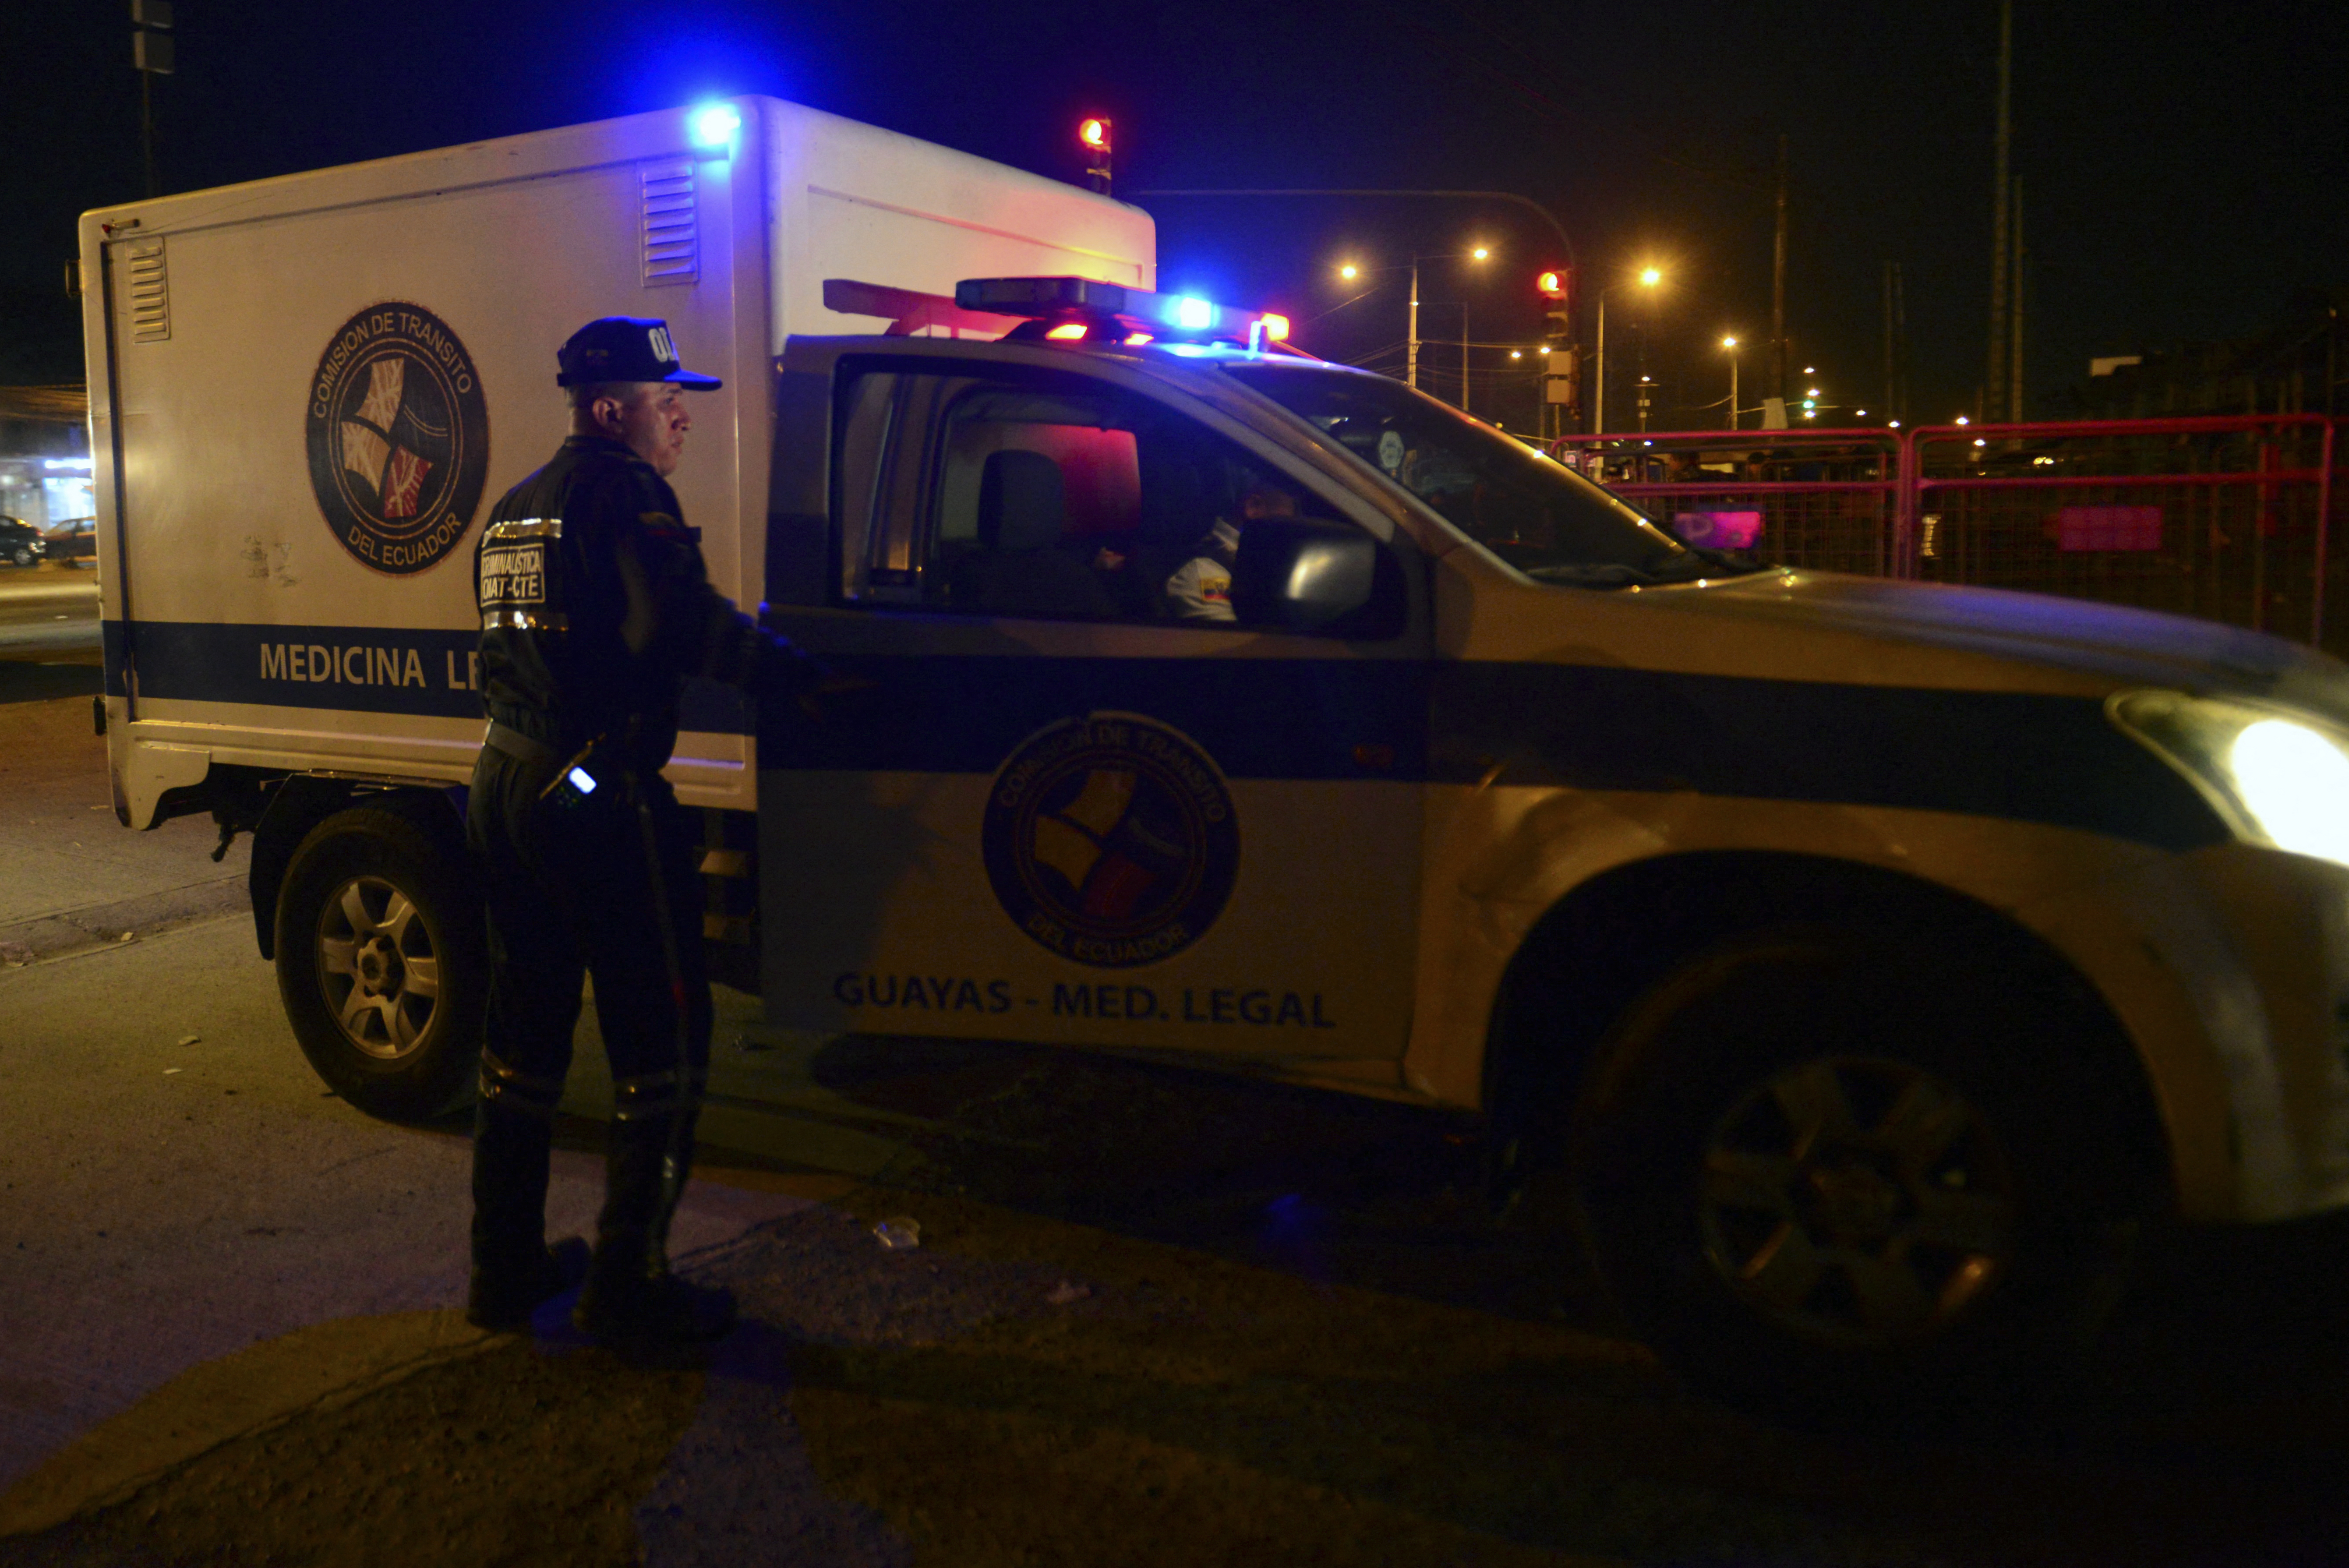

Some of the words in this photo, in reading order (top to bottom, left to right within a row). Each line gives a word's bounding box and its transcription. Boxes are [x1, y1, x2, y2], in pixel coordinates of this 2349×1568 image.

[314, 321, 368, 418] COMISION
[371, 312, 395, 335] DE
[399, 313, 472, 393] TRANSITO
[348, 526, 378, 561] DEL
[382, 512, 462, 565] ECUADOR
[482, 551, 541, 576] CRIMINALISTICA
[261, 643, 426, 688] MEDICINA
[1098, 722, 1130, 745] DE
[1137, 728, 1226, 822] TRANSITO
[1028, 913, 1066, 952] DEL
[1074, 922, 1189, 963] ECUADOR
[834, 972, 1012, 1014] GUAYAS
[1052, 983, 1169, 1022] MED.
[1183, 988, 1336, 1028] LEGAL
